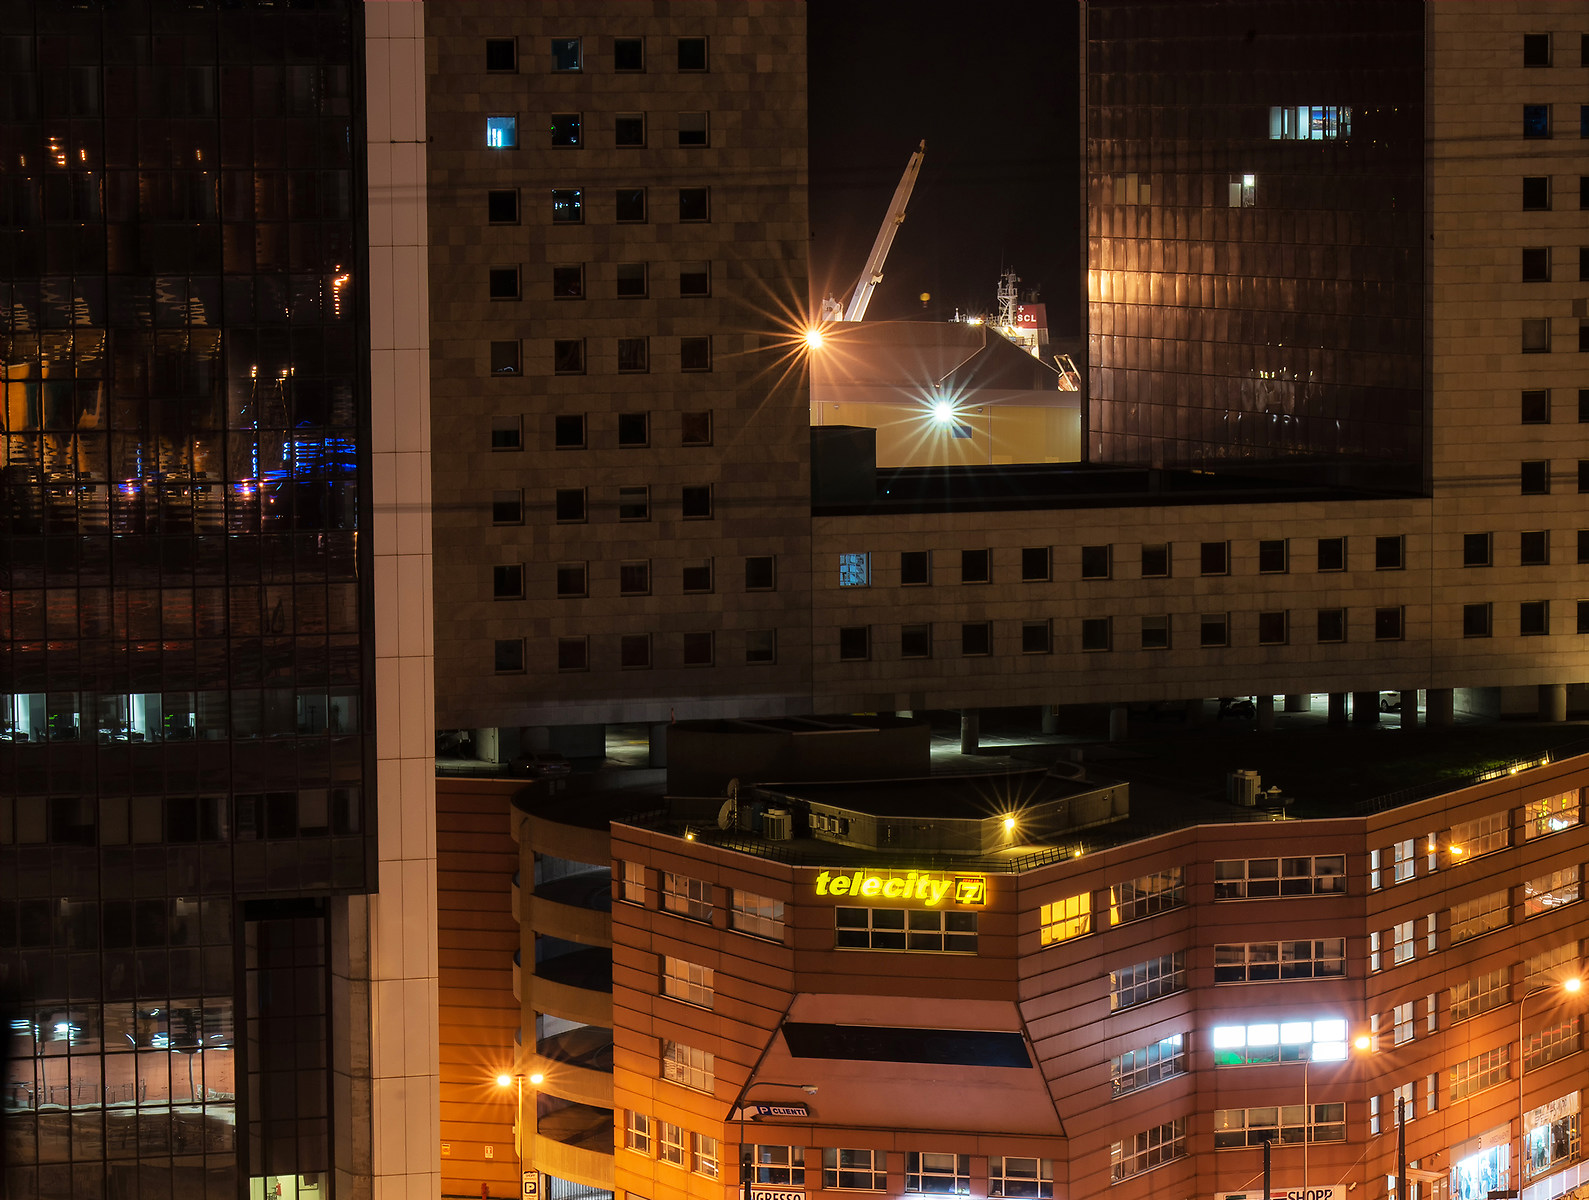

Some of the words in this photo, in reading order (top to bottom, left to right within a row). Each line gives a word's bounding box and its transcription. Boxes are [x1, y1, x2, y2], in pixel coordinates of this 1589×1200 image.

[1017, 314, 1037, 322] SCL
[815, 870, 952, 906] telecity
[772, 1108, 806, 1116] CLIENTI
